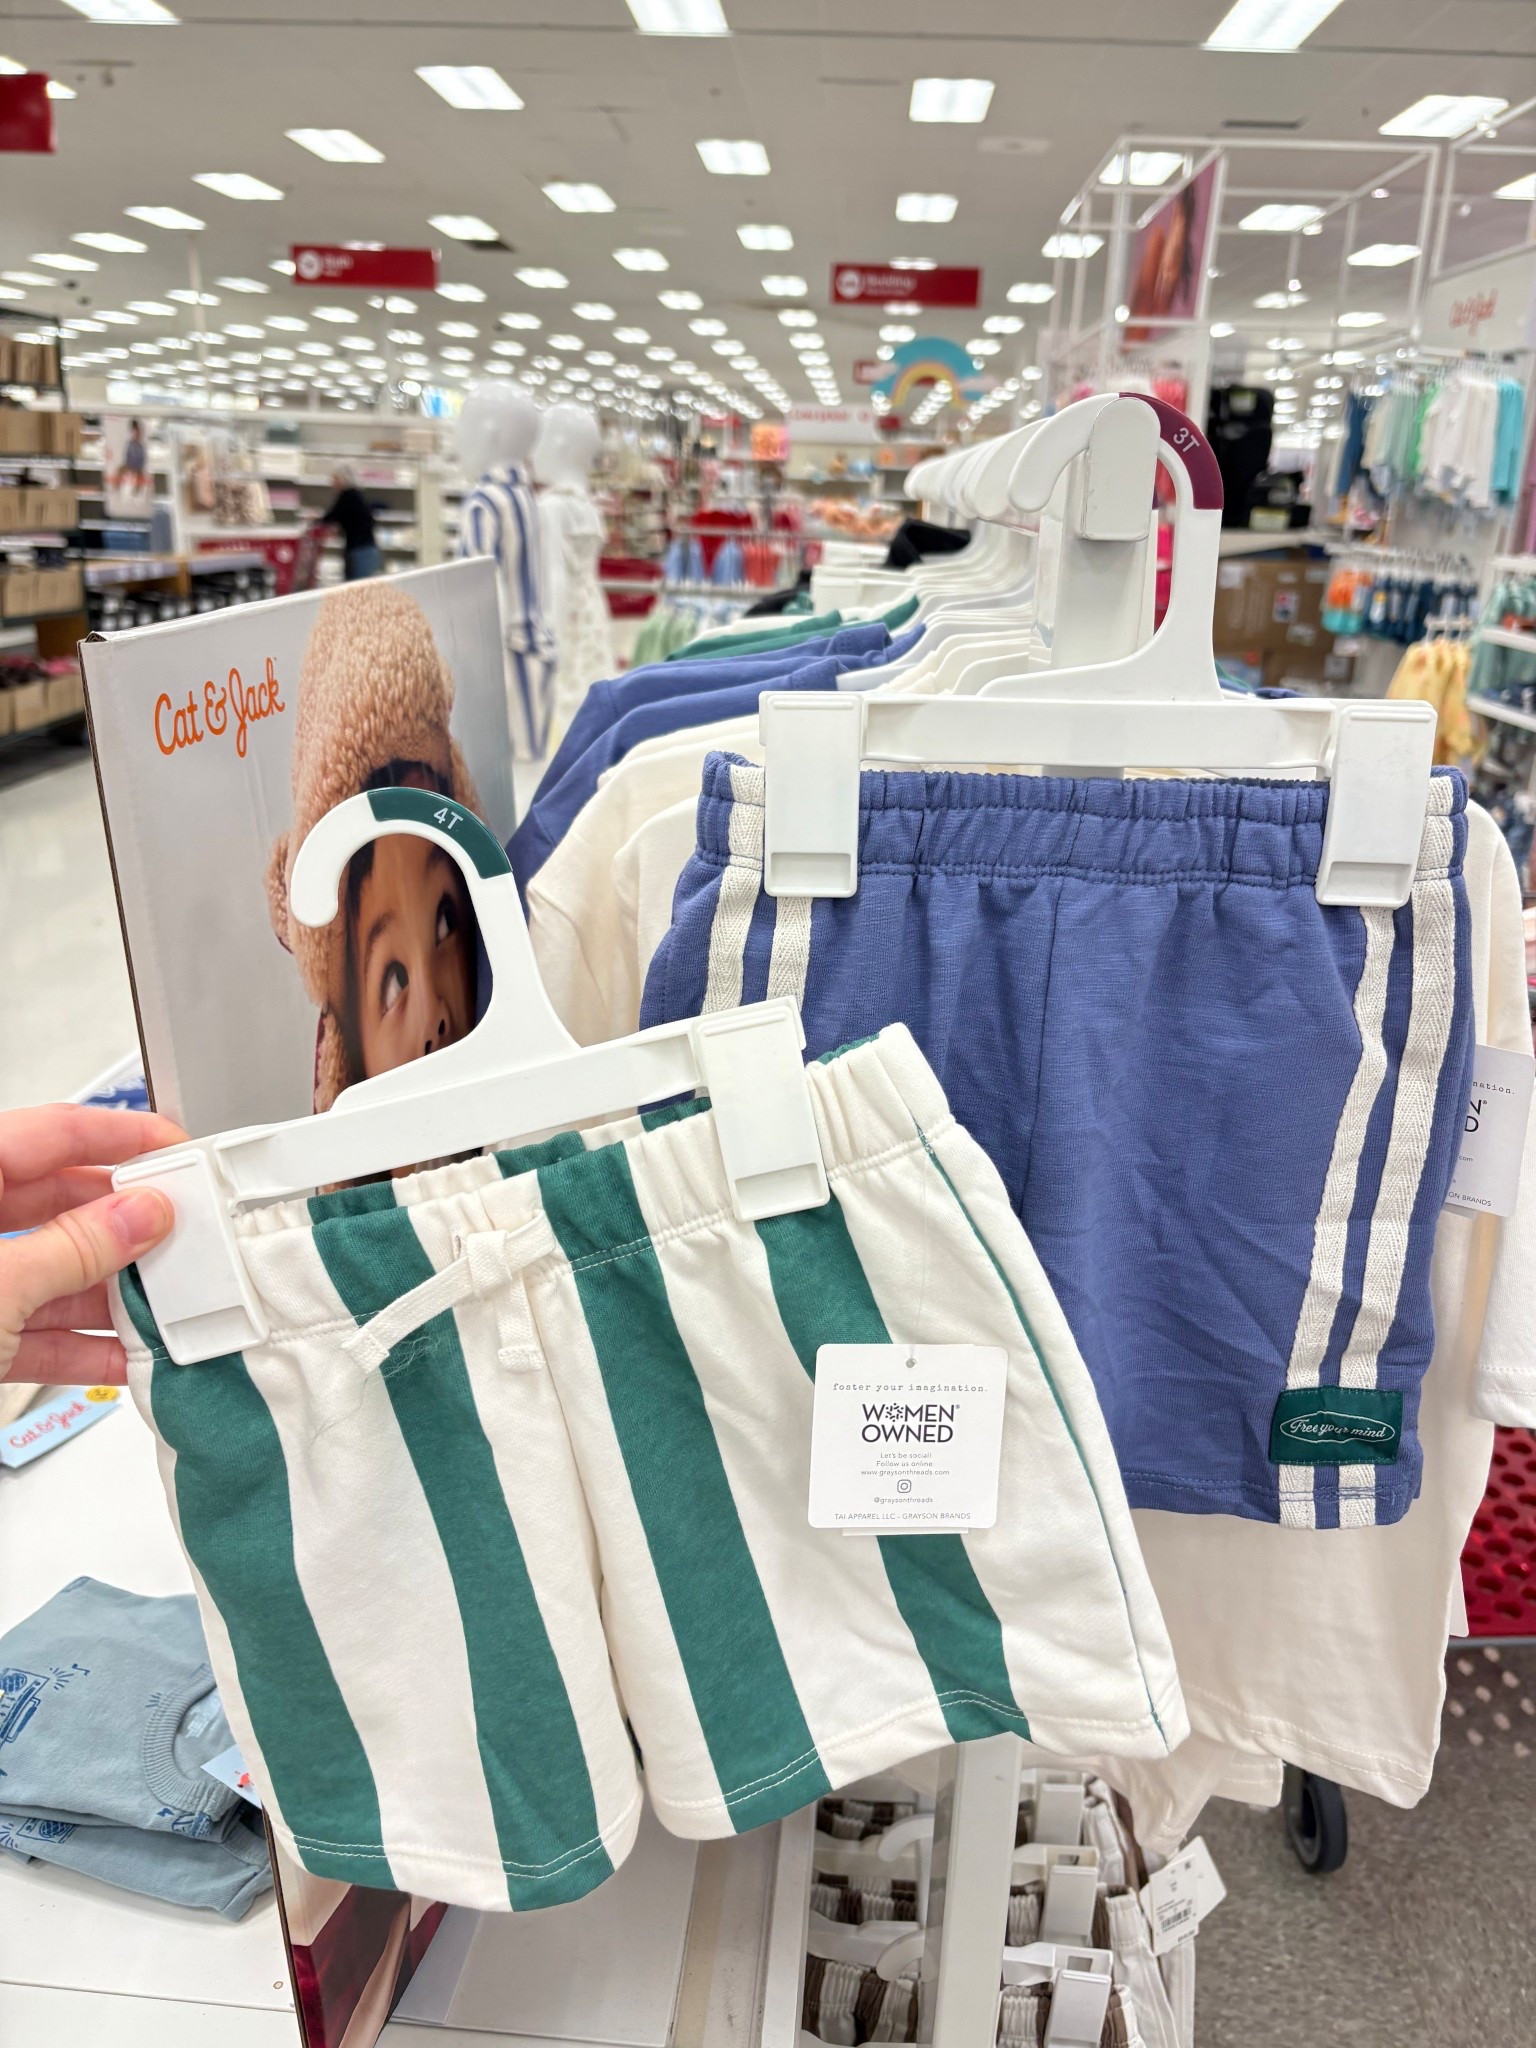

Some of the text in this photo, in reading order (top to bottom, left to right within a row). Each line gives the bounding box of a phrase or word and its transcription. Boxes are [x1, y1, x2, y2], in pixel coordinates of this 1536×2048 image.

[1173, 427, 1200, 453] 3T
[154, 657, 285, 758] Cat & Jack
[433, 807, 464, 830] 4T
[1472, 1081, 1515, 1095] nation.
[1462, 1194, 1492, 1206] BRANDS
[833, 1382, 988, 1393] foster your imagination.
[861, 1424, 954, 1443] OWNED
[1289, 1418, 1387, 1438] Free your mind
[873, 1496, 934, 1504] @graysonthreads
[902, 1512, 938, 1520] GRAYSON
[940, 1512, 971, 1520] BRANDS
